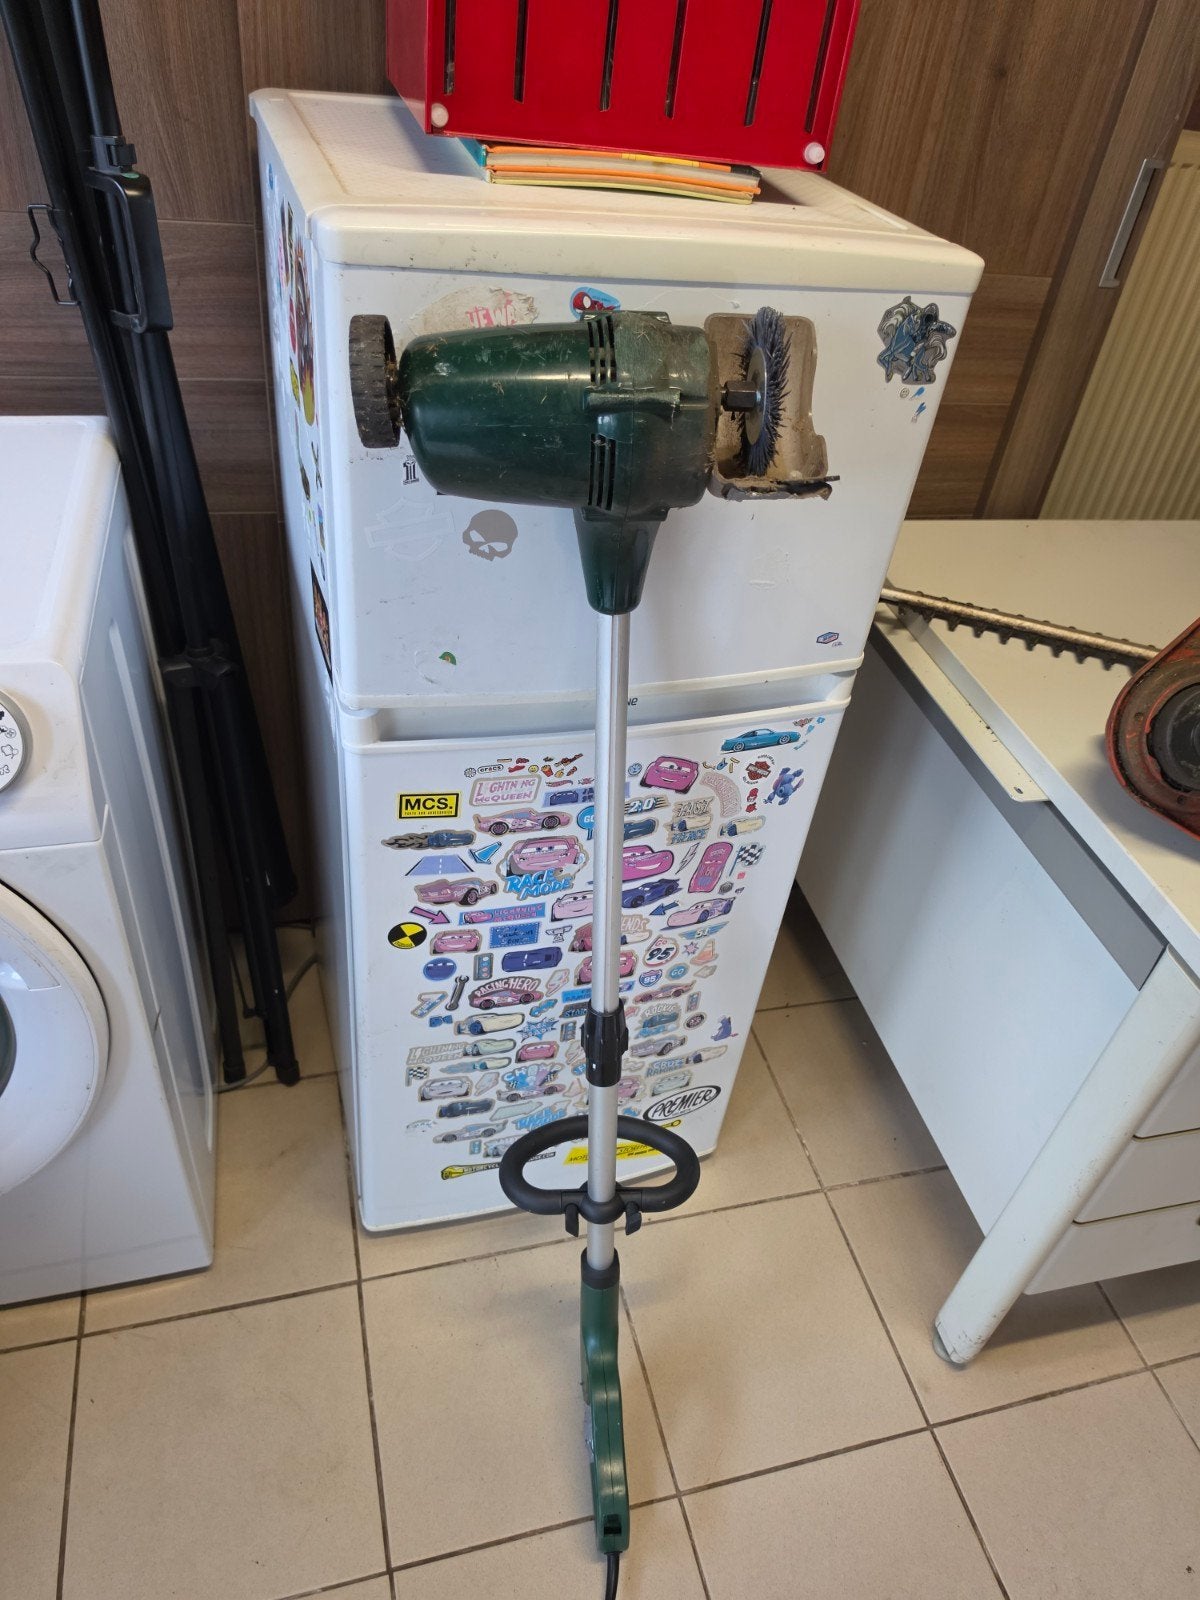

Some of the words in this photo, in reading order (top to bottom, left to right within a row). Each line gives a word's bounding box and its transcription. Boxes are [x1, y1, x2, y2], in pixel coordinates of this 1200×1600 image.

[404, 797, 453, 811] MCS.
[505, 867, 556, 893] RACE
[620, 917, 647, 932] ENDS
[647, 947, 675, 960] 95
[644, 975, 657, 983] 95
[671, 968, 685, 976] GO
[474, 980, 509, 997] RACING
[508, 978, 539, 992] HERO
[651, 1088, 713, 1118] PREMIER
